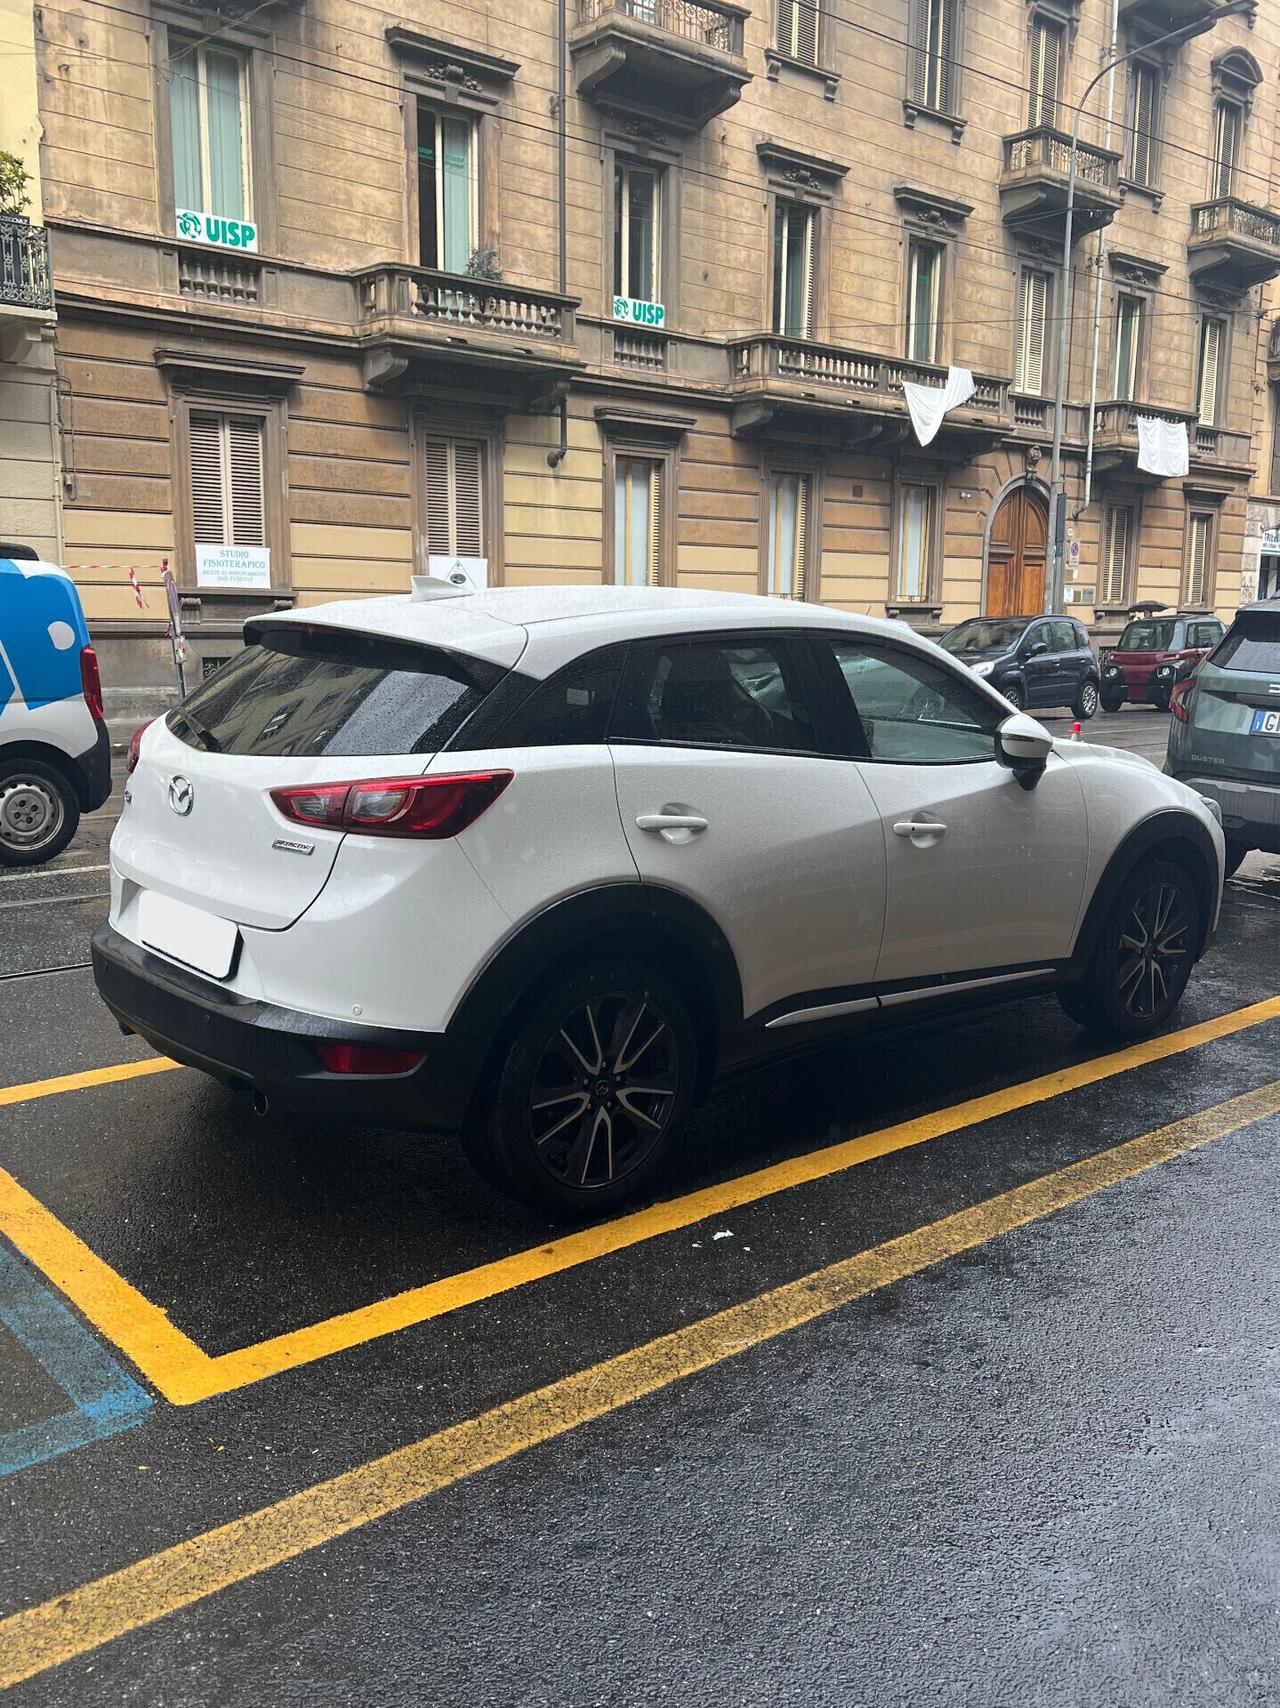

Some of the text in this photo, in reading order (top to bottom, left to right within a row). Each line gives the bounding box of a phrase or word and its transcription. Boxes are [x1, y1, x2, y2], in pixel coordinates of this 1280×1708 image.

[206, 217, 255, 248] UISP
[632, 301, 665, 325] UISP
[219, 550, 250, 559] STUDIO
[202, 559, 266, 569] FISIOTERAPICO
[1191, 754, 1225, 765] DUSTER
